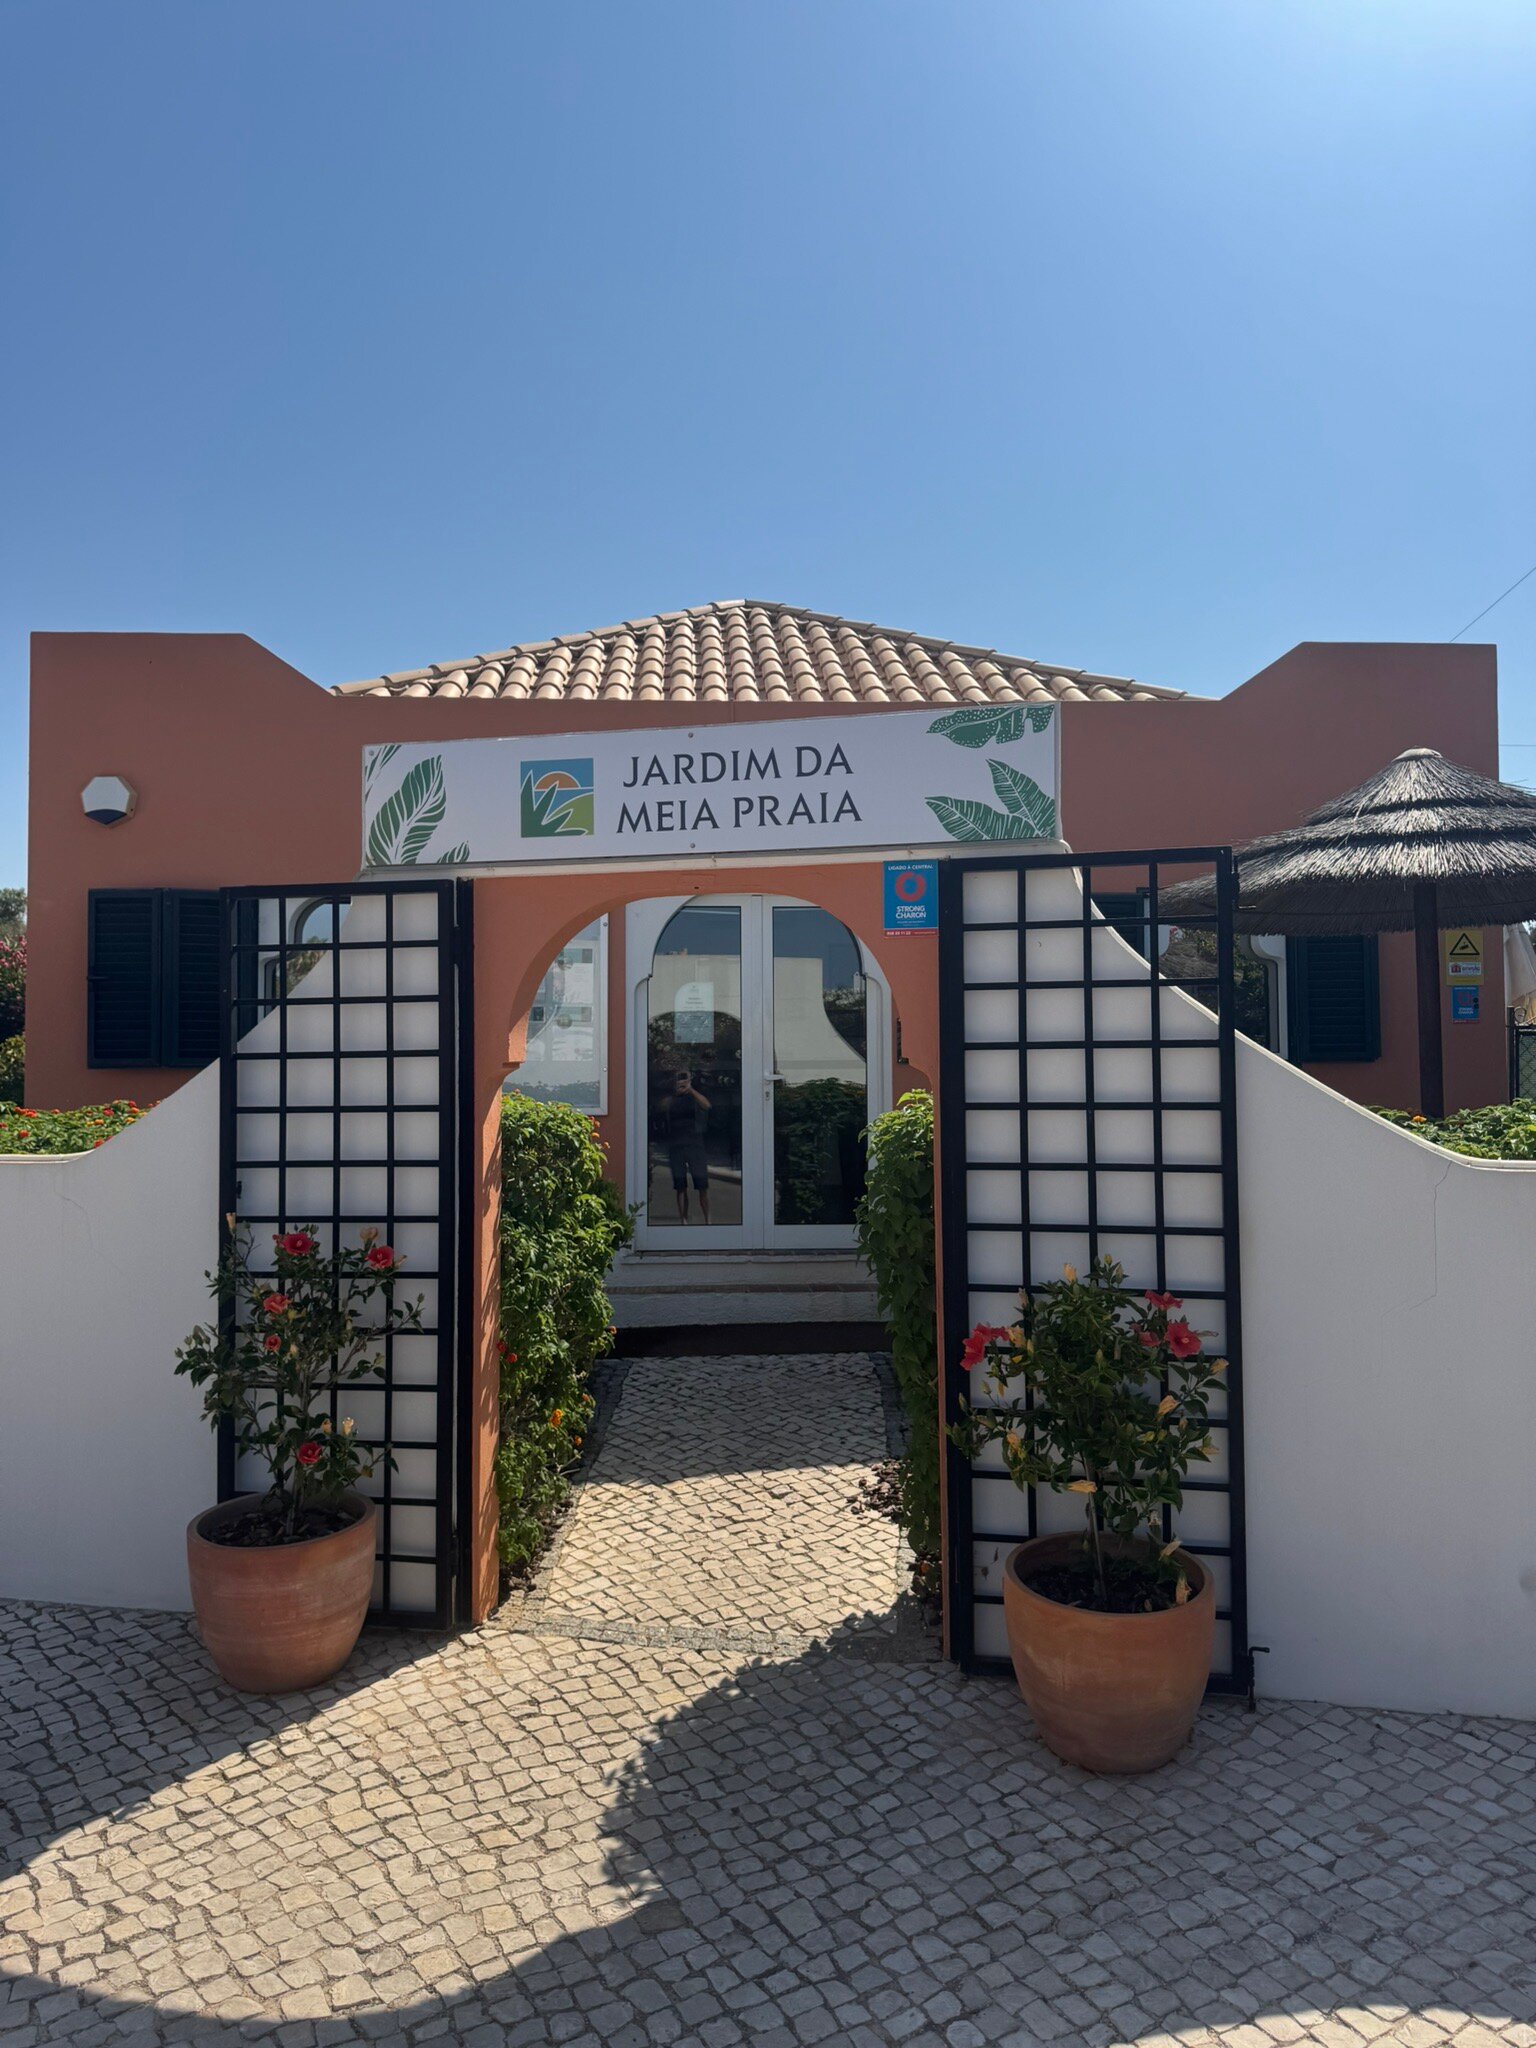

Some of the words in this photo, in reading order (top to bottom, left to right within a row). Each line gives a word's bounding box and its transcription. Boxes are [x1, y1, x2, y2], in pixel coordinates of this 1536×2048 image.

[623, 746, 782, 788] JARDIM
[795, 742, 854, 778] DA
[616, 797, 720, 834] MEIA
[733, 789, 863, 828] PRAIA
[896, 911, 926, 919] CHARON
